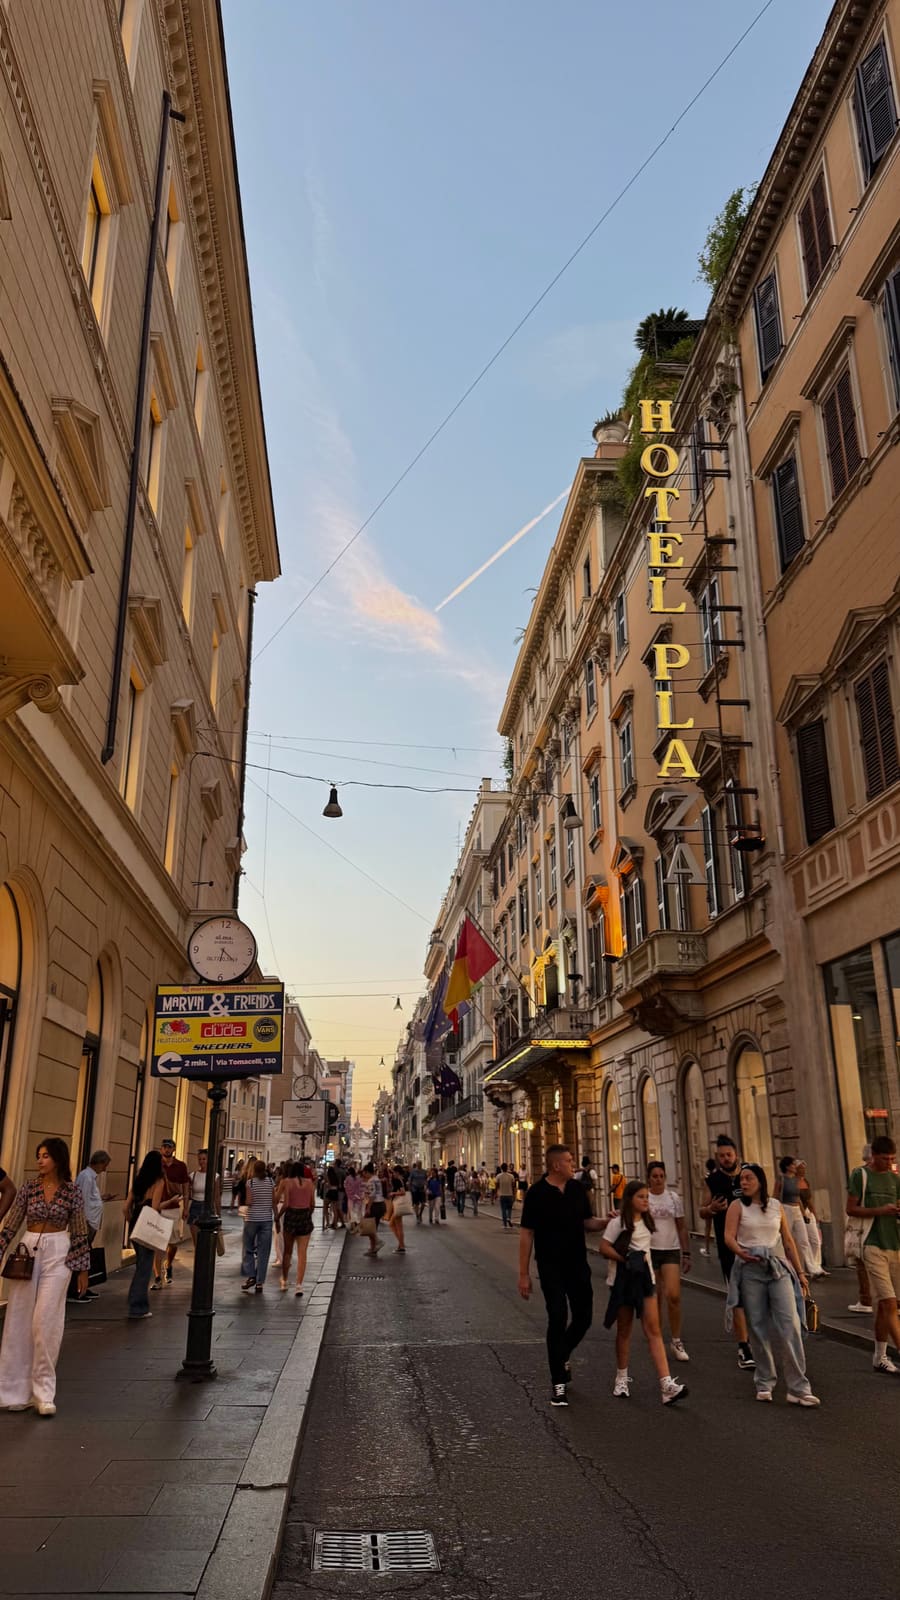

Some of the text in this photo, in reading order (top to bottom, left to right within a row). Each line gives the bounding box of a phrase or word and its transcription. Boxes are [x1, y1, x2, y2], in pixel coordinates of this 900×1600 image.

[638, 399, 706, 885] HOTEL PLAZA
[221, 920, 231, 928] 12
[193, 946, 200, 954] 9
[247, 948, 253, 956] 3
[208, 993, 230, 1017] &
[233, 994, 275, 1010] FRIENDS
[203, 1024, 244, 1037] dude
[256, 1025, 275, 1033] VANS
[193, 1043, 252, 1051] SKECHERS
[191, 1059, 208, 1067] min.
